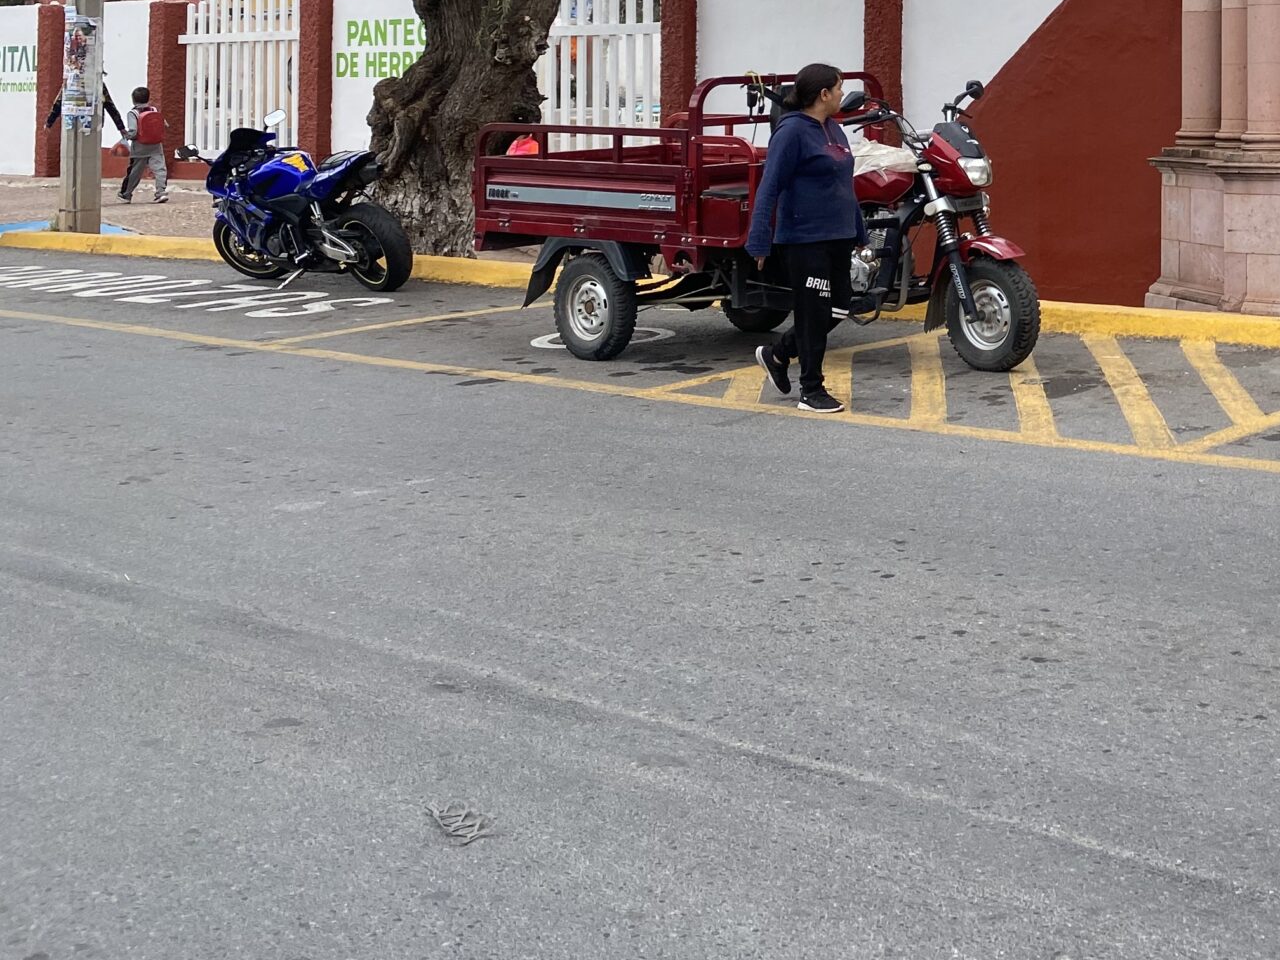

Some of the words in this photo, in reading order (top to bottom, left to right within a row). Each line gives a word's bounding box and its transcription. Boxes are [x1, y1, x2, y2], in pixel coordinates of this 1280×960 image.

[0, 44, 38, 73] ITAL
[336, 52, 359, 78] DE
[365, 51, 424, 78] HERR
